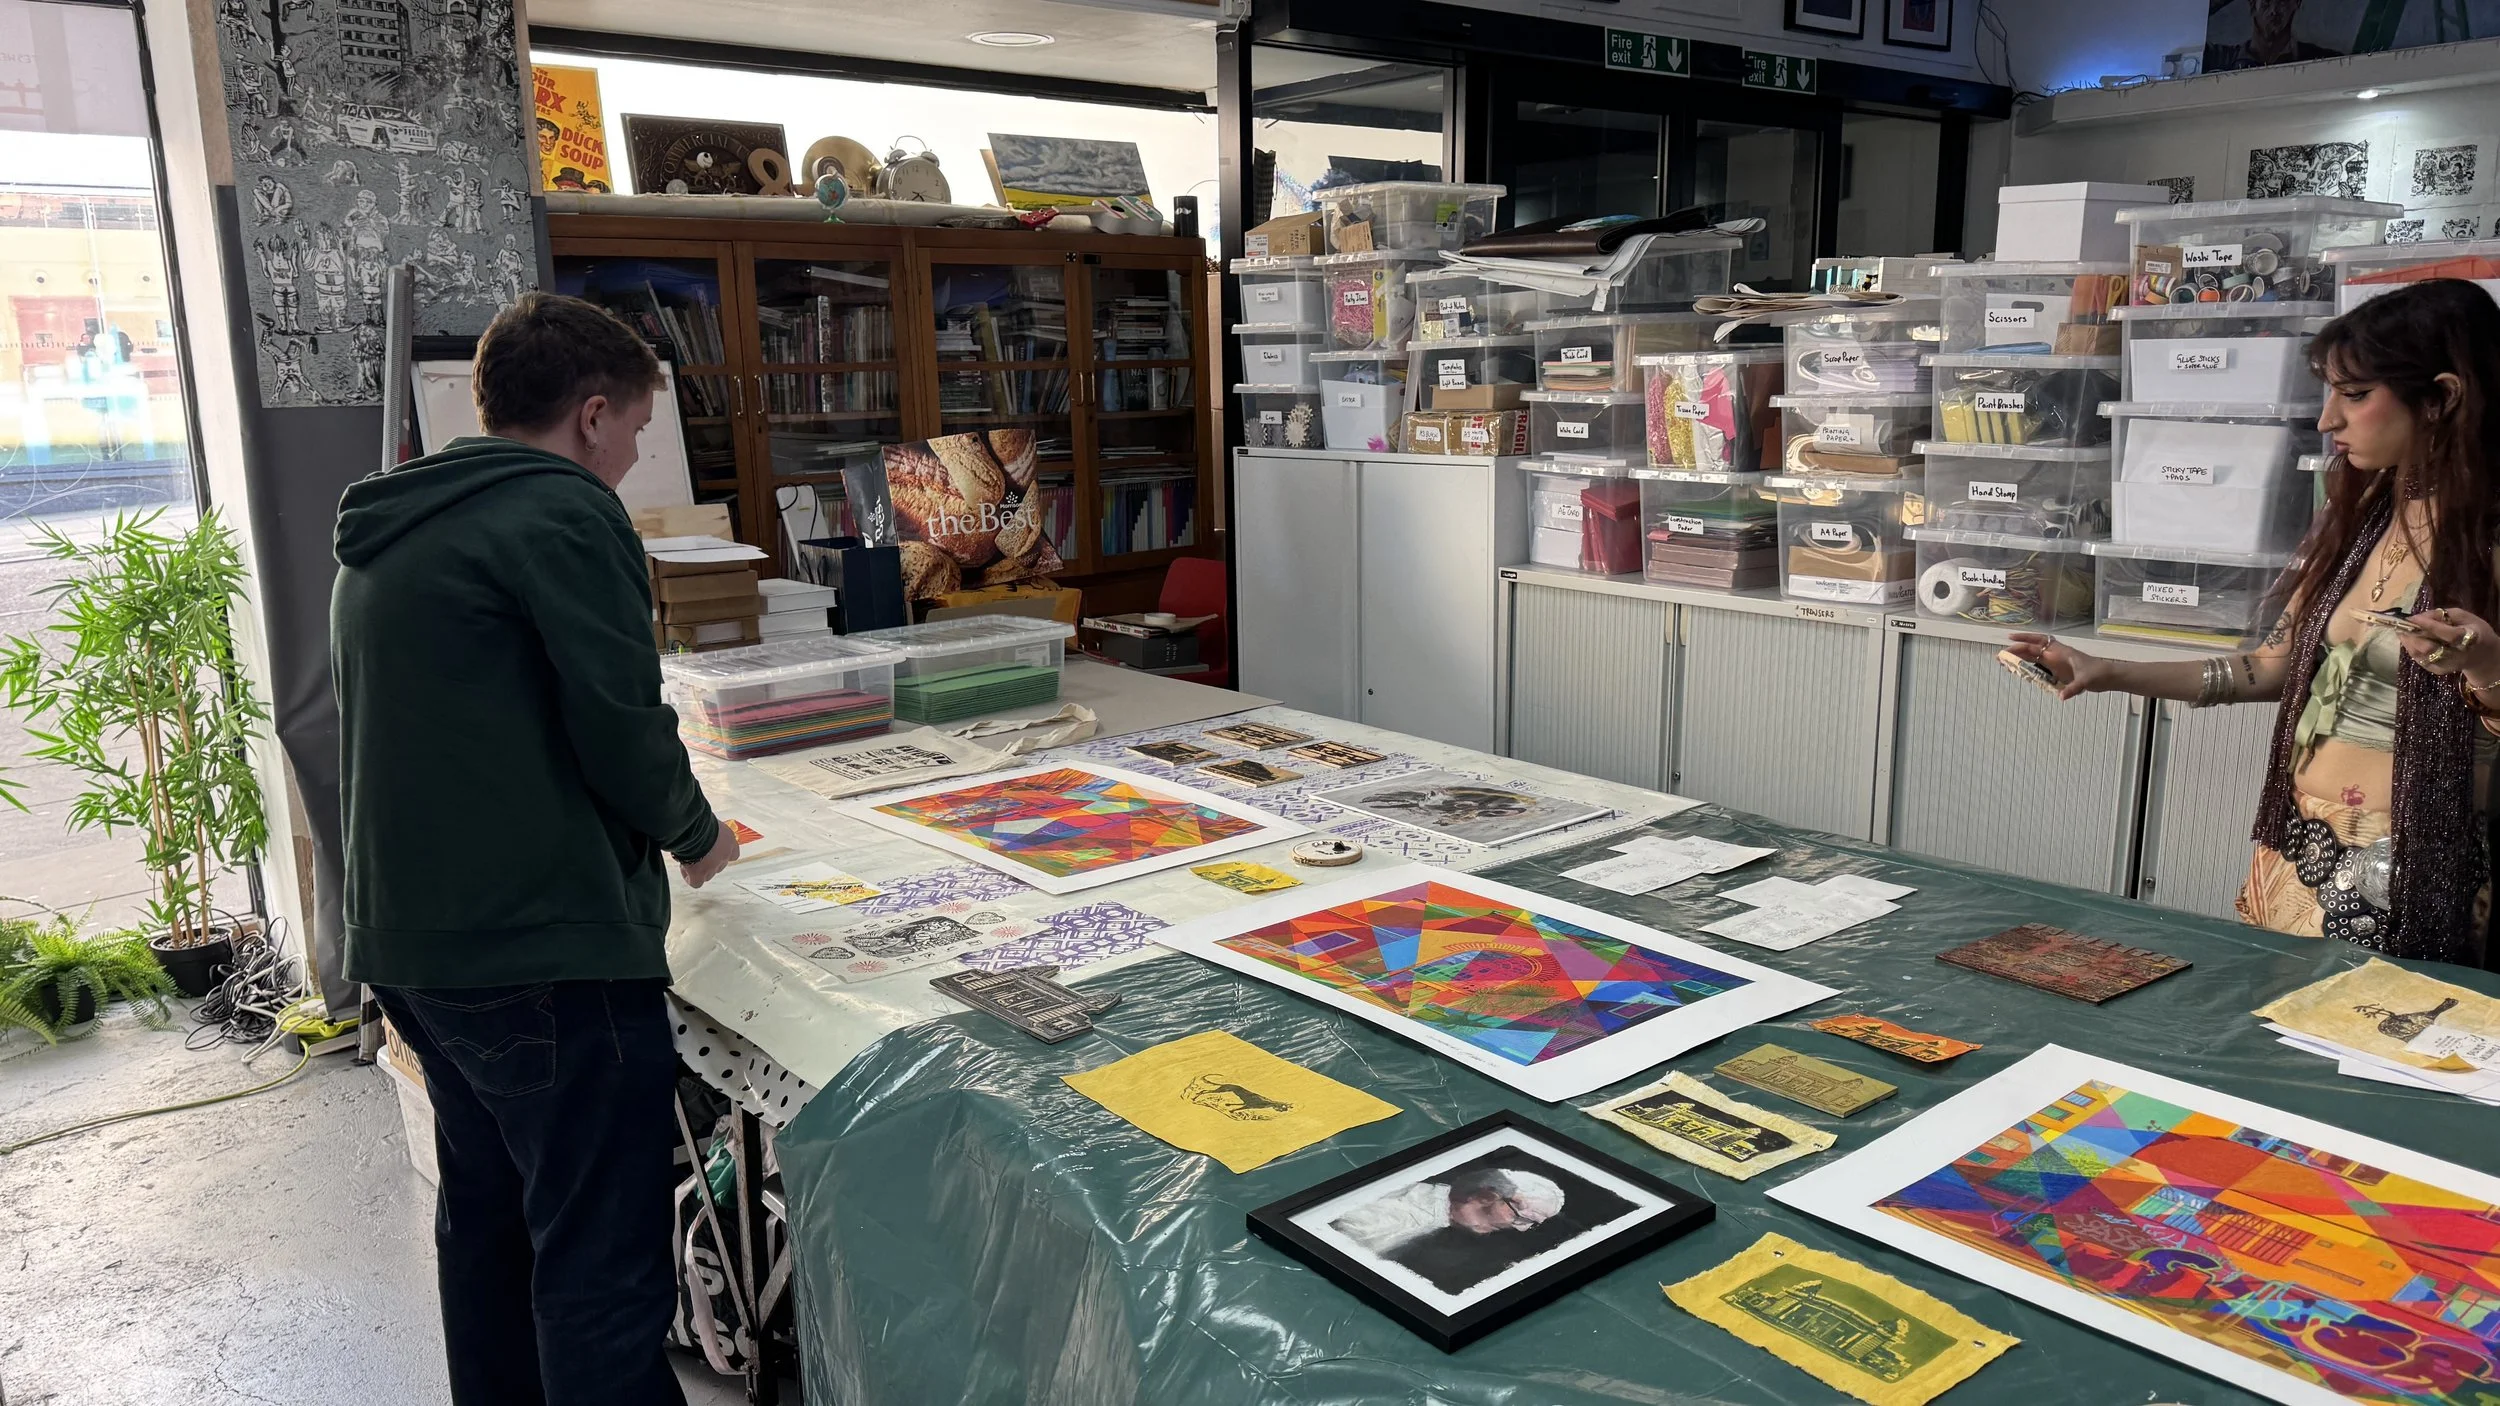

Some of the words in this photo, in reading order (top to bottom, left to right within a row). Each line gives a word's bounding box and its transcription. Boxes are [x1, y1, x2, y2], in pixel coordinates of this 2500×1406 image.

[1611, 34, 1632, 50] Fire
[1611, 50, 1631, 64] exit
[531, 72, 556, 91] OUR
[1748, 70, 1765, 84] exit
[535, 86, 567, 113] RX
[561, 127, 604, 156] DUCK
[560, 144, 604, 170] SOUP
[2185, 251, 2209, 263] Washi
[2212, 249, 2233, 263] Tape
[1988, 311, 2027, 323] Scissors
[1576, 350, 1588, 359] Card
[1824, 353, 1842, 364] Scrap
[1842, 352, 1860, 363] Paper
[2176, 354, 2195, 363] GLUE
[2198, 354, 2220, 364] STICKS
[1676, 405, 1692, 415] Tissue
[1692, 406, 1706, 416] Paper
[1822, 427, 1850, 436] PRINTING
[1826, 434, 1847, 442] PAPER
[2161, 465, 2185, 475] STICKY
[2186, 467, 2208, 476] TAPE
[1971, 486, 1993, 497] Hand
[1995, 487, 2016, 500] Stamp
[1669, 516, 1702, 525] Construction
[1677, 524, 1693, 532] Paper
[1832, 528, 1847, 538] Paper
[2146, 585, 2174, 593] MIXED
[2150, 594, 2188, 604] STICKERS
[1800, 607, 1834, 618] TROUSERS
